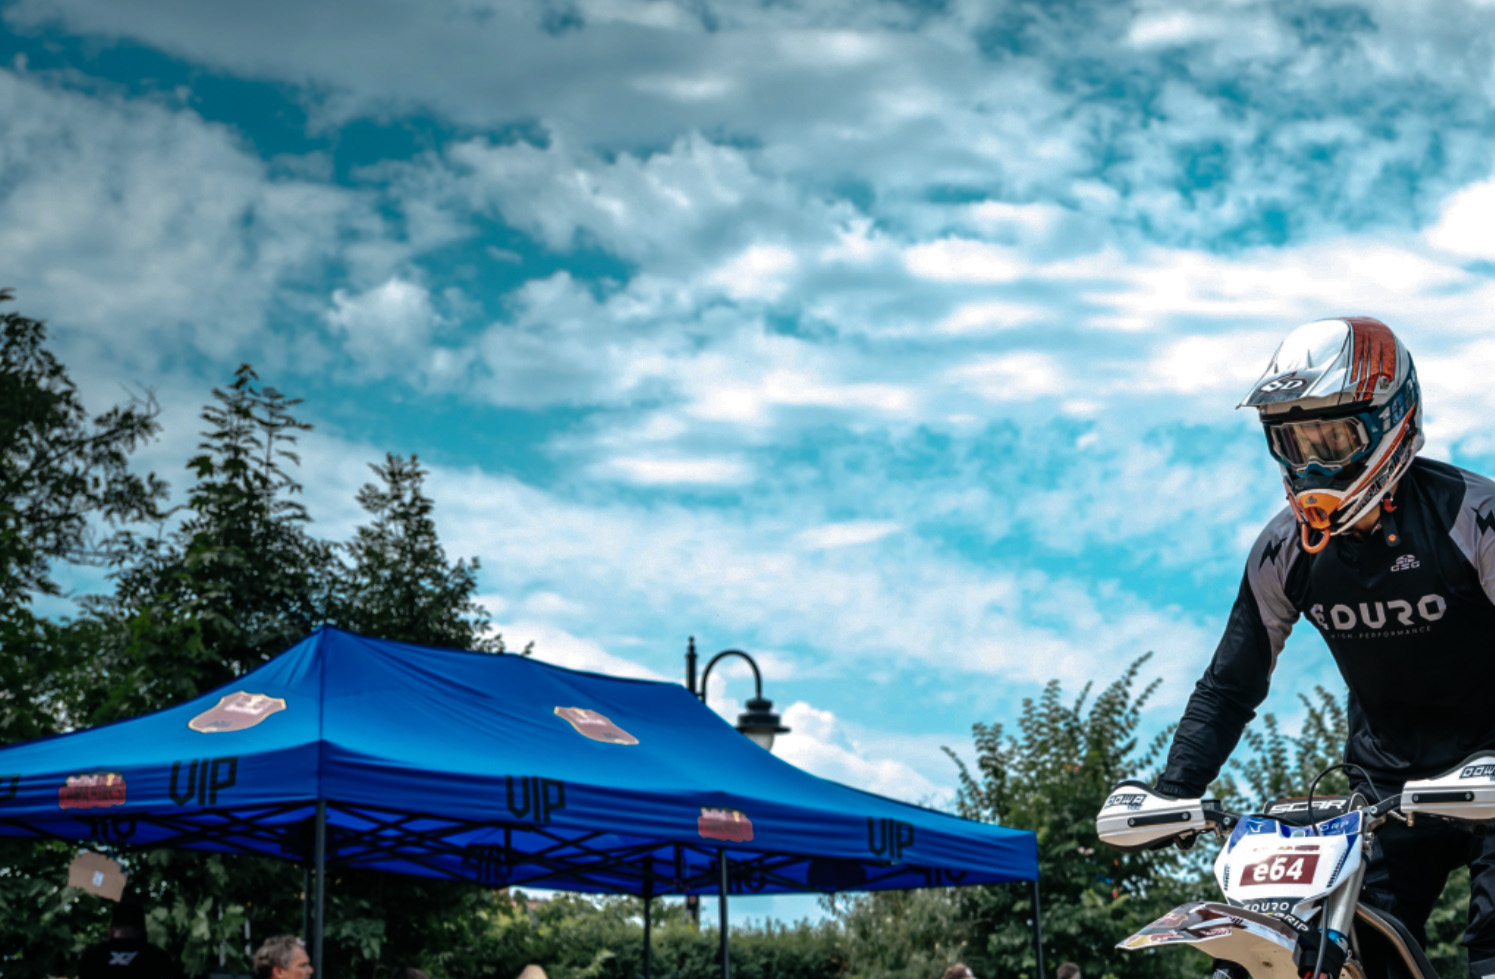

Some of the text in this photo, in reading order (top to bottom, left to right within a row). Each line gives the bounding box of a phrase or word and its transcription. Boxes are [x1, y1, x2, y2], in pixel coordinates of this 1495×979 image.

[168, 756, 238, 806] VIP
[504, 775, 565, 823] VIP
[1268, 800, 1347, 814] SCAR
[867, 816, 914, 859] VIP
[1252, 856, 1304, 881] e64
